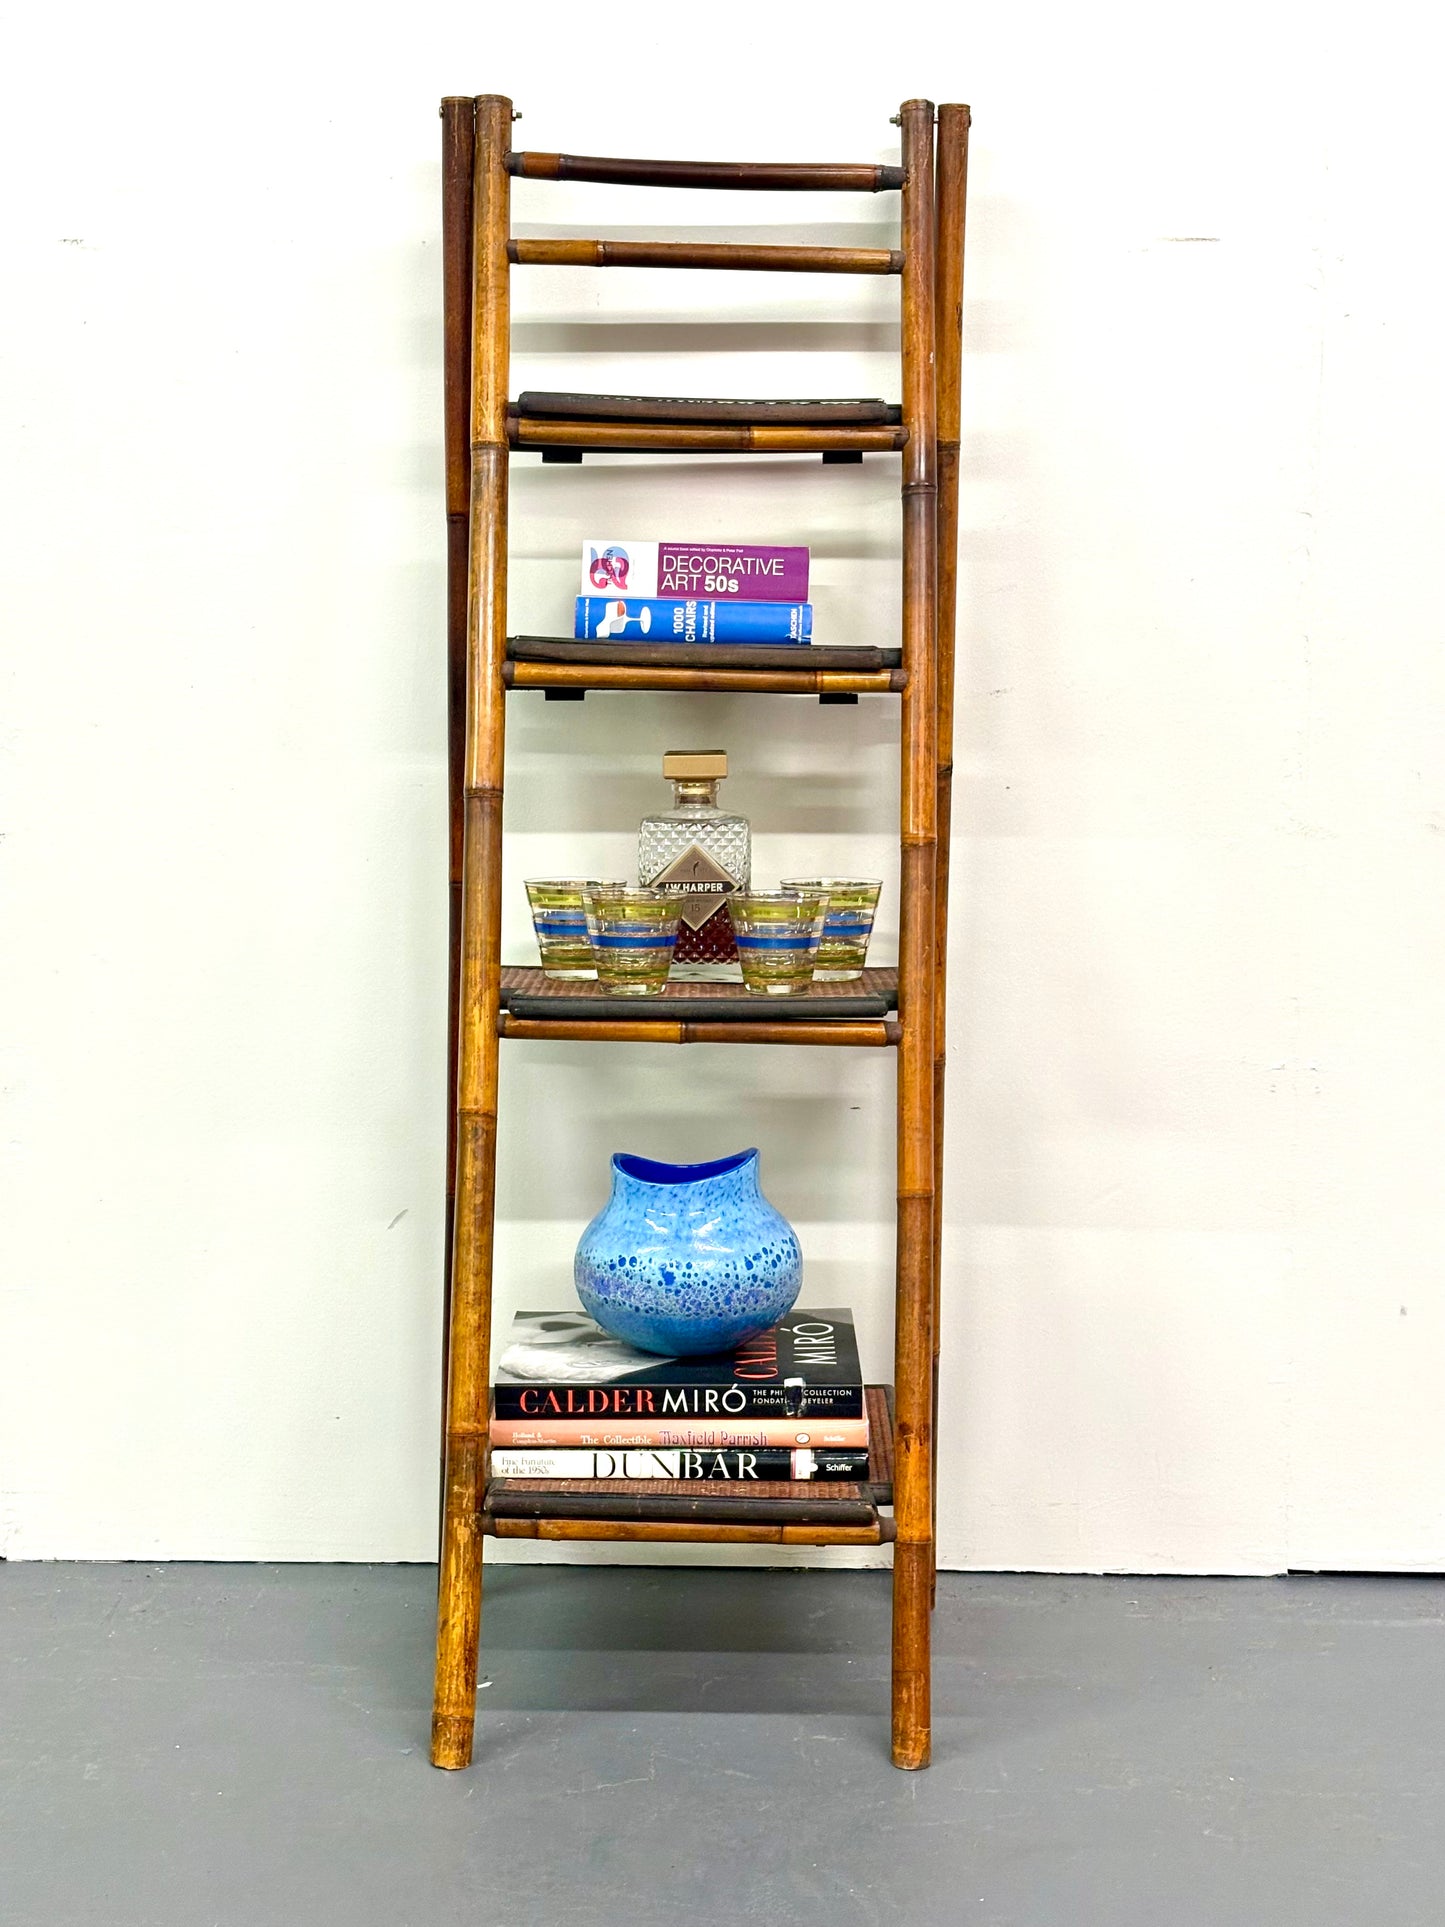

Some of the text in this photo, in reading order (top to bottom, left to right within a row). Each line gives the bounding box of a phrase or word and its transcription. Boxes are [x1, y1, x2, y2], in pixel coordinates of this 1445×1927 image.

[663, 555, 785, 576] DECORATIVE
[661, 573, 739, 593] ART 50s
[673, 607, 684, 634] 1000
[685, 600, 697, 643] CHAIRS
[683, 883, 724, 893] HARPER
[780, 1323, 837, 1365] MIRÓ
[519, 1383, 747, 1414] CALDER MIRÓ
[581, 1431, 768, 1446] The Collectible Maxfield Parrish
[593, 1453, 759, 1479] DUNBAR
[826, 1463, 852, 1472] Schiffer
